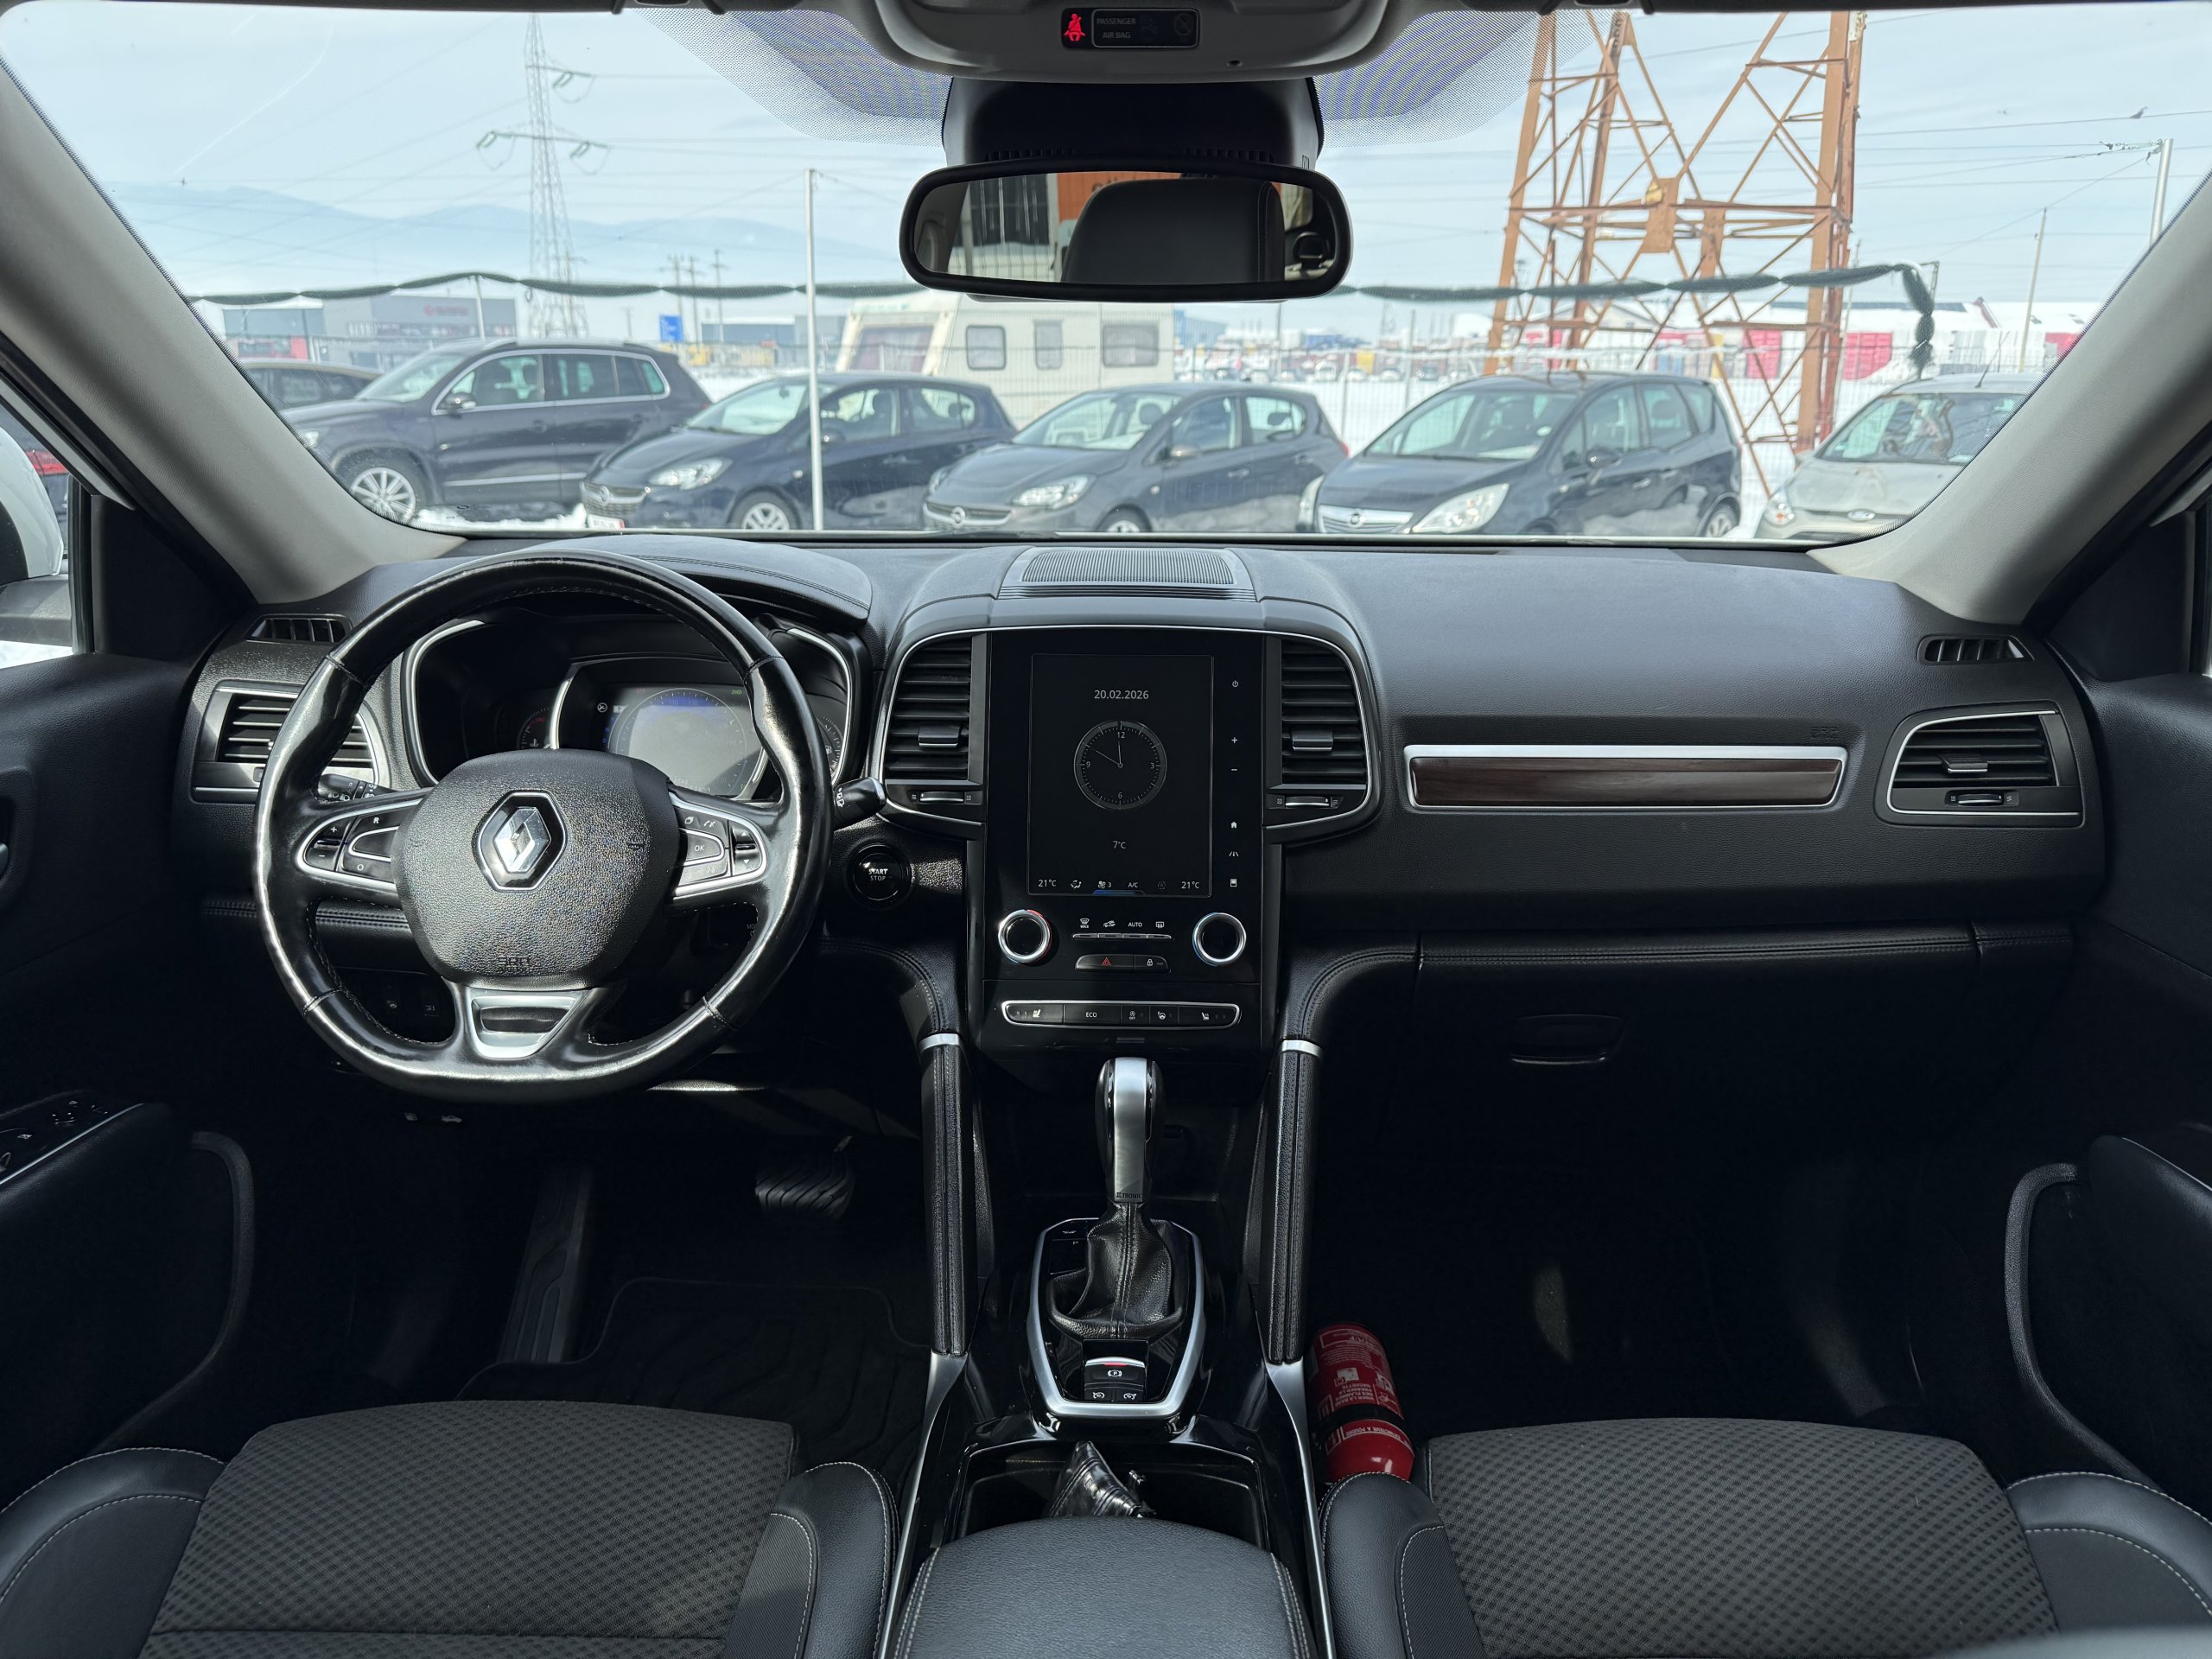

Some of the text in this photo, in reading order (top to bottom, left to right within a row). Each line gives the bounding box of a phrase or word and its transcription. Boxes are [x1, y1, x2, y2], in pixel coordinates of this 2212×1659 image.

[1094, 690, 1149, 700] 20.02.2026
[1113, 840, 1127, 849] 7°C
[1038, 879, 1057, 887] 21°C
[1181, 880, 1200, 889] 21°C
